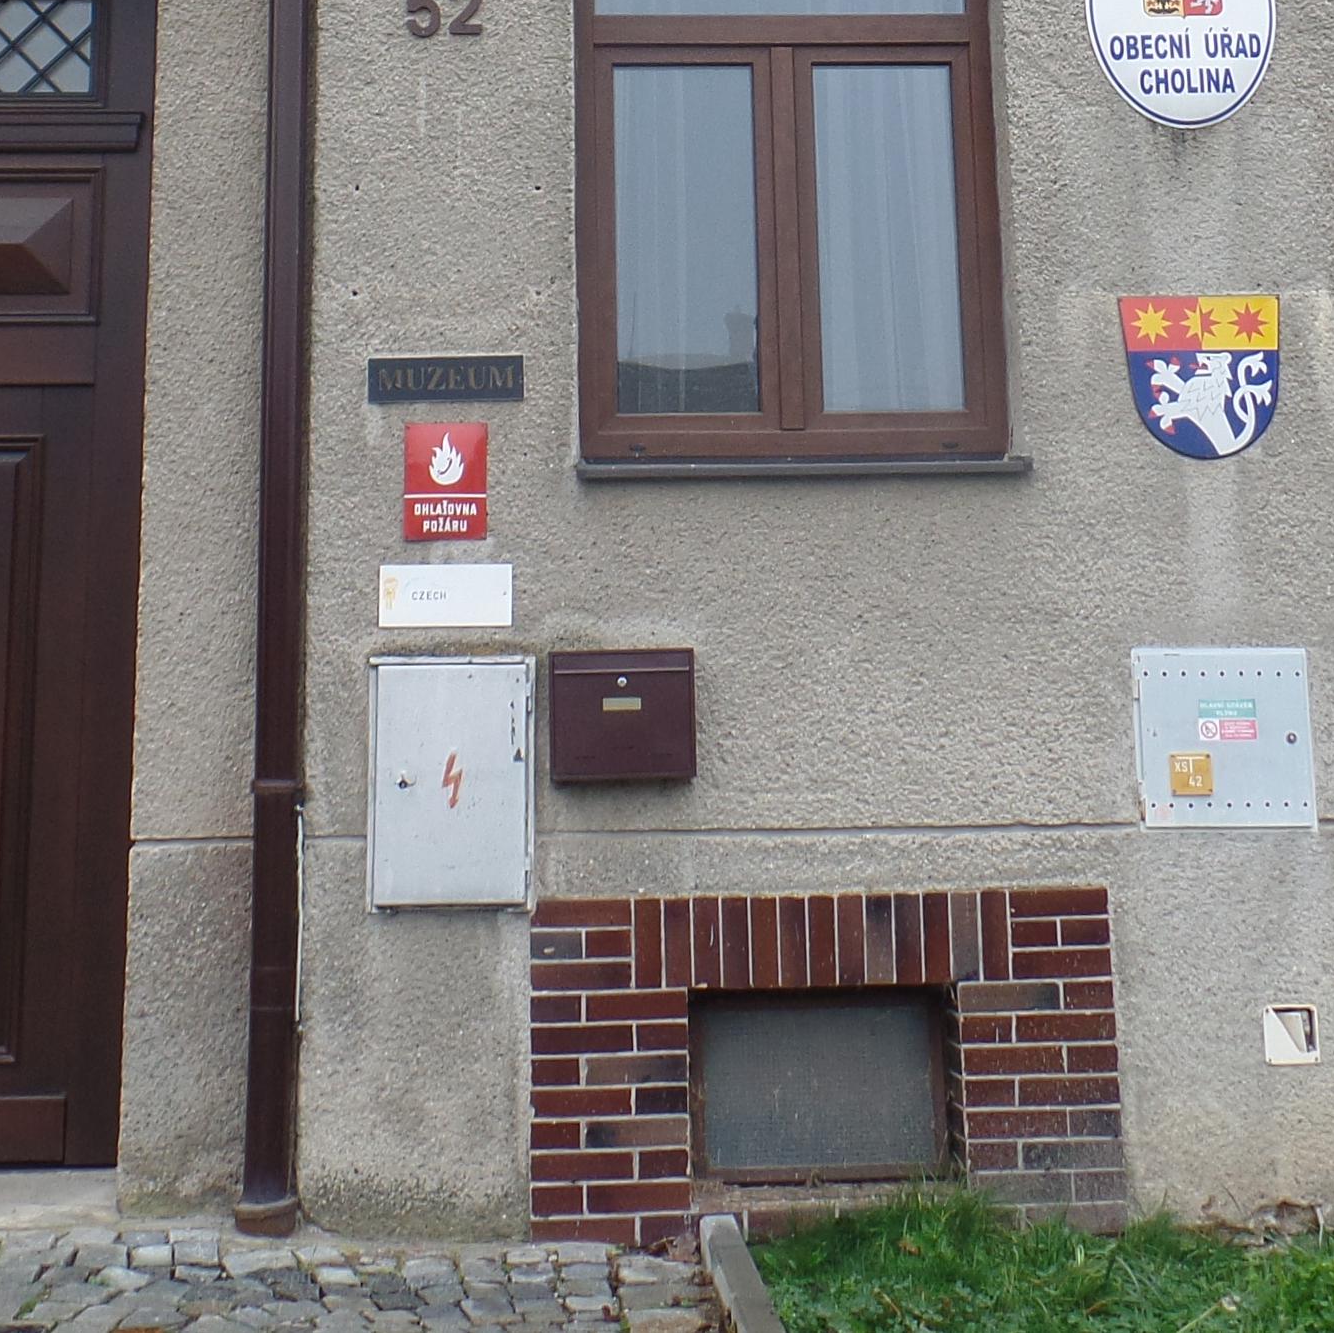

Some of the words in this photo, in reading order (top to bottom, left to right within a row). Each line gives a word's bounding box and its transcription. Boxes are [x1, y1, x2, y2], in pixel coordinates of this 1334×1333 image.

[1109, 28, 1191, 61] OBECNÍ
[1204, 27, 1261, 59] ÚŘAD
[1140, 68, 1236, 95] CHOLINA
[377, 365, 515, 391] MUZEUM
[414, 500, 477, 516] OHLAŠOVNA
[423, 517, 467, 533] POŽÁRU
[411, 591, 447, 601] CZECH
[1189, 775, 1203, 787] 42
